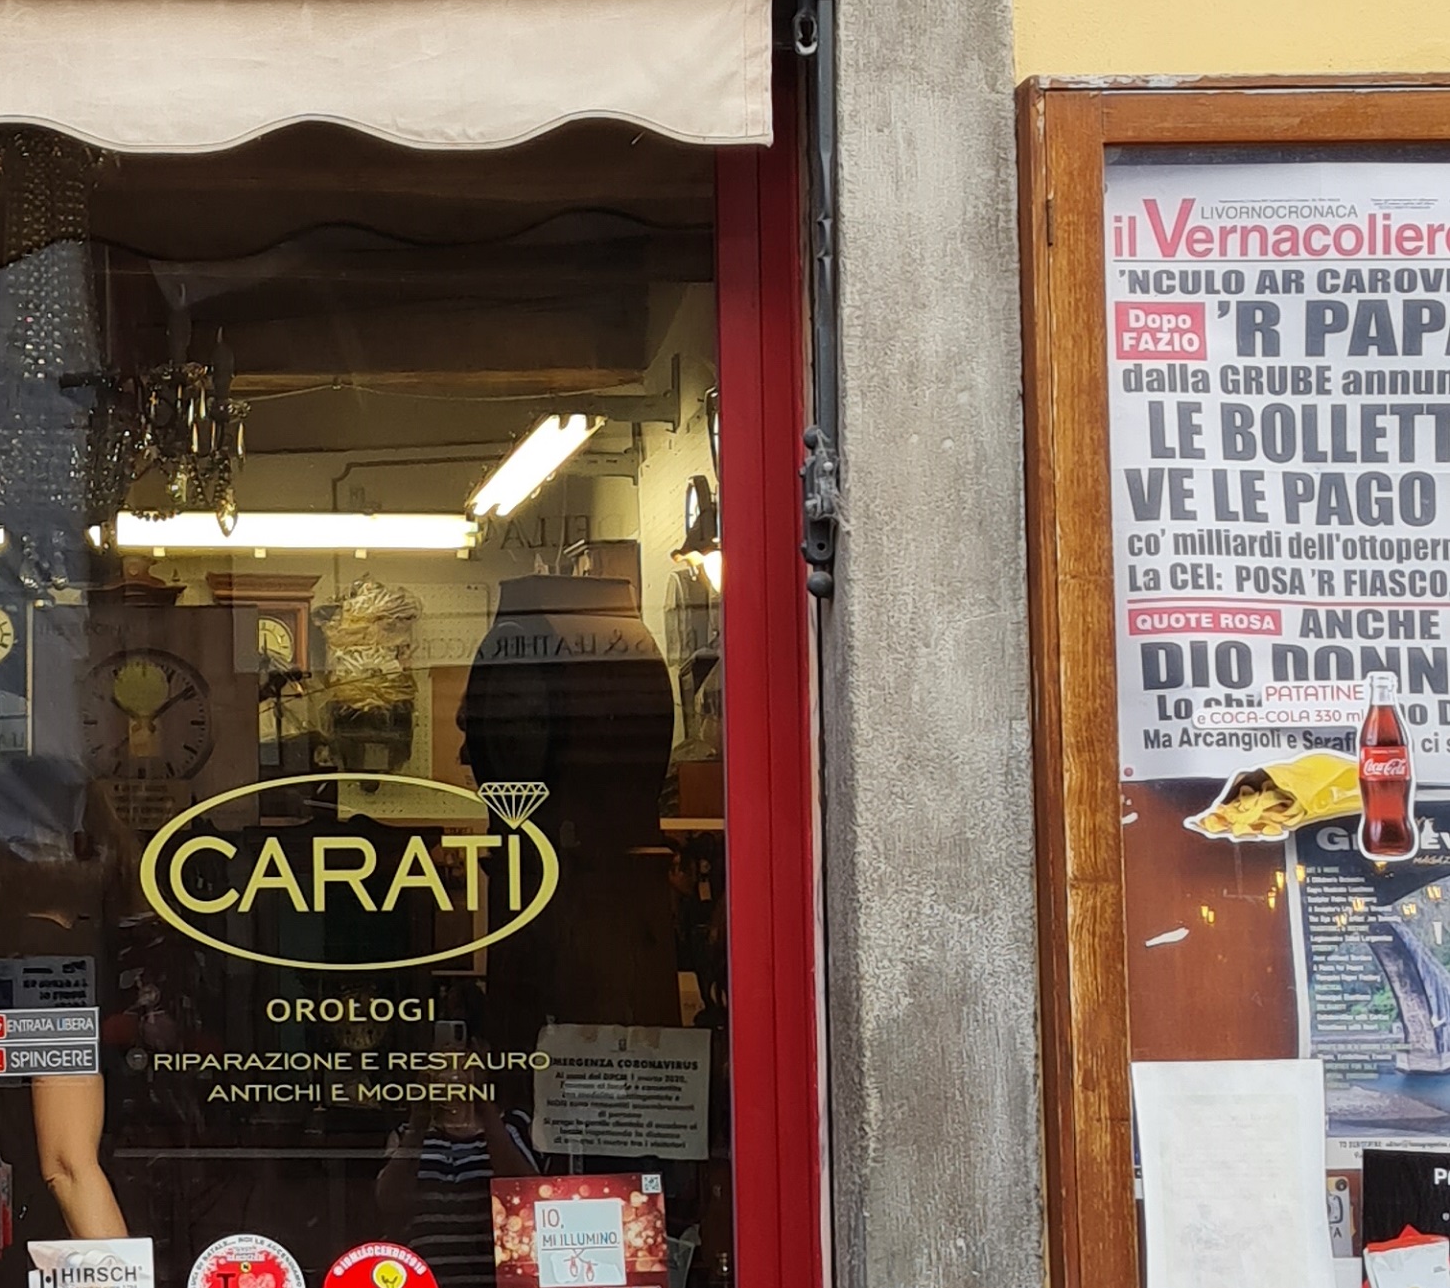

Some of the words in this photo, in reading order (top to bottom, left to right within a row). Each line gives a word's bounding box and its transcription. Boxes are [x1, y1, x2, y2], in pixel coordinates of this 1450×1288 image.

[1201, 205, 1358, 219] LIVORNOCRONACA
[1113, 215, 1136, 257] il
[1143, 198, 1450, 258] Vernacolier
[1255, 269, 1305, 294] AR
[1317, 268, 1450, 294] CAROV
[1128, 309, 1191, 333] Dopo
[1305, 299, 1450, 357] PAP
[1122, 332, 1200, 352] FAZIO
[1122, 364, 1211, 393] dalla
[1220, 365, 1332, 395] GRUBE
[1148, 401, 1205, 459] LE
[1124, 468, 1198, 522] VE
[1212, 468, 1269, 523] LE
[1282, 471, 1436, 527] PAGO
[1173, 529, 1282, 558] milliardi
[1289, 532, 1450, 565] dell'ottoper
[1127, 565, 1161, 592] La
[1170, 563, 1223, 591] CEI:
[1236, 565, 1305, 595] POSA
[1344, 569, 1450, 597] FIASCO
[1136, 613, 1214, 629] QUOTE
[1220, 614, 1275, 630] ROSA
[1300, 607, 1440, 640] ANCHE
[1140, 640, 1253, 691] DIO
[1265, 685, 1364, 702] PATATINE
[1210, 710, 1309, 725] COCA-COLA
[1315, 709, 1341, 723] 330
[1346, 709, 1363, 723] ml
[1143, 729, 1173, 749] Ma
[1179, 728, 1281, 752] Arcangioli
[1289, 734, 1298, 749] e
[169, 834, 522, 913] CARATI
[266, 998, 435, 1023] OROLOGI
[7, 1018, 54, 1032] ENTRATA
[57, 1017, 94, 1031] LIBERA
[10, 1050, 93, 1068] SPINGERE
[153, 1052, 352, 1071] RIPARAZIONE
[360, 1052, 379, 1071] E
[388, 1052, 550, 1071] RESTAURO
[618, 1059, 698, 1071] CORONAVIRUS
[207, 1083, 321, 1102] ANTICHI
[331, 1083, 349, 1102] E
[358, 1083, 495, 1102] MODERNI
[542, 1208, 564, 1229] IO,
[542, 1234, 557, 1247] MI
[61, 1266, 137, 1283] HIRSCH
